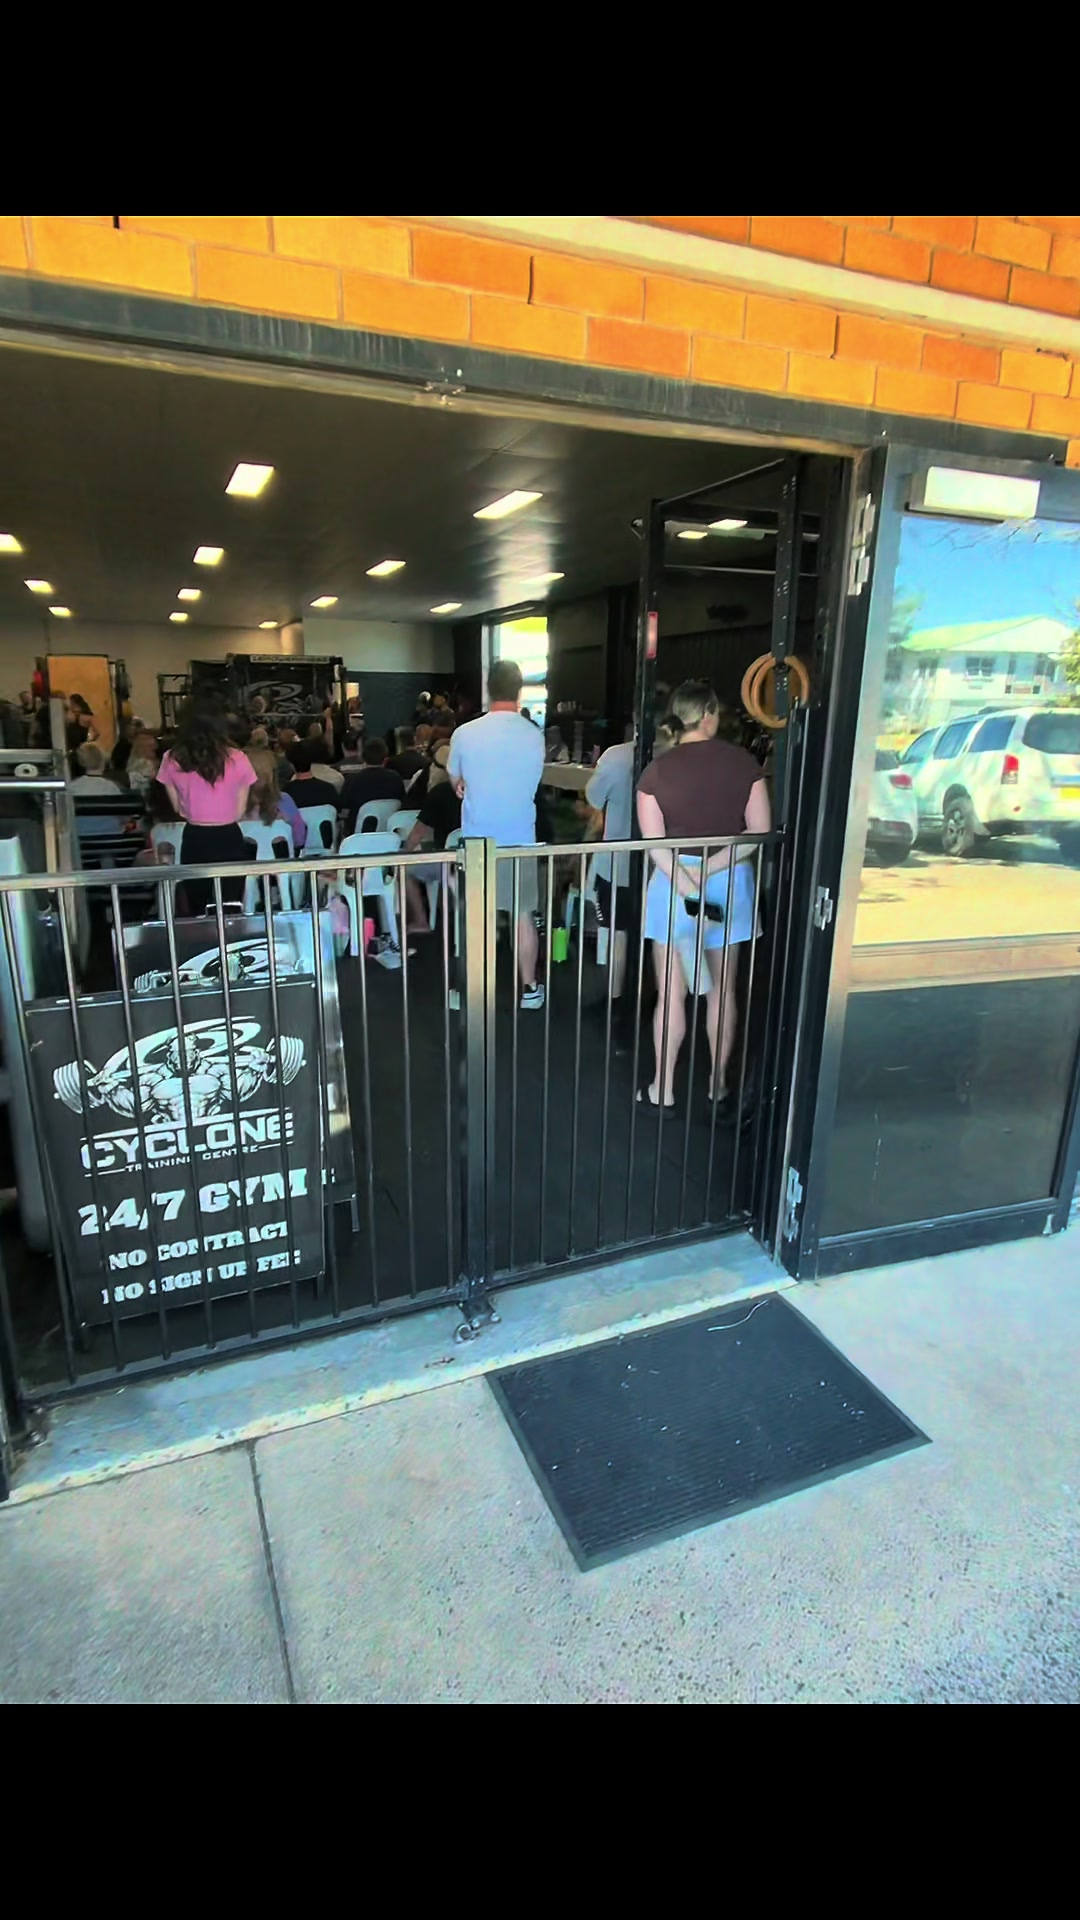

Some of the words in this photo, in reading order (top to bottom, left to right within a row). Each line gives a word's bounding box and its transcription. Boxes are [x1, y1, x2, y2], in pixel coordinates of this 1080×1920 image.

[80, 1113, 293, 1169] CYCLONE
[78, 1189, 186, 1236] 24/7
[199, 1168, 308, 1213] GYM
[108, 1249, 147, 1271] NO
